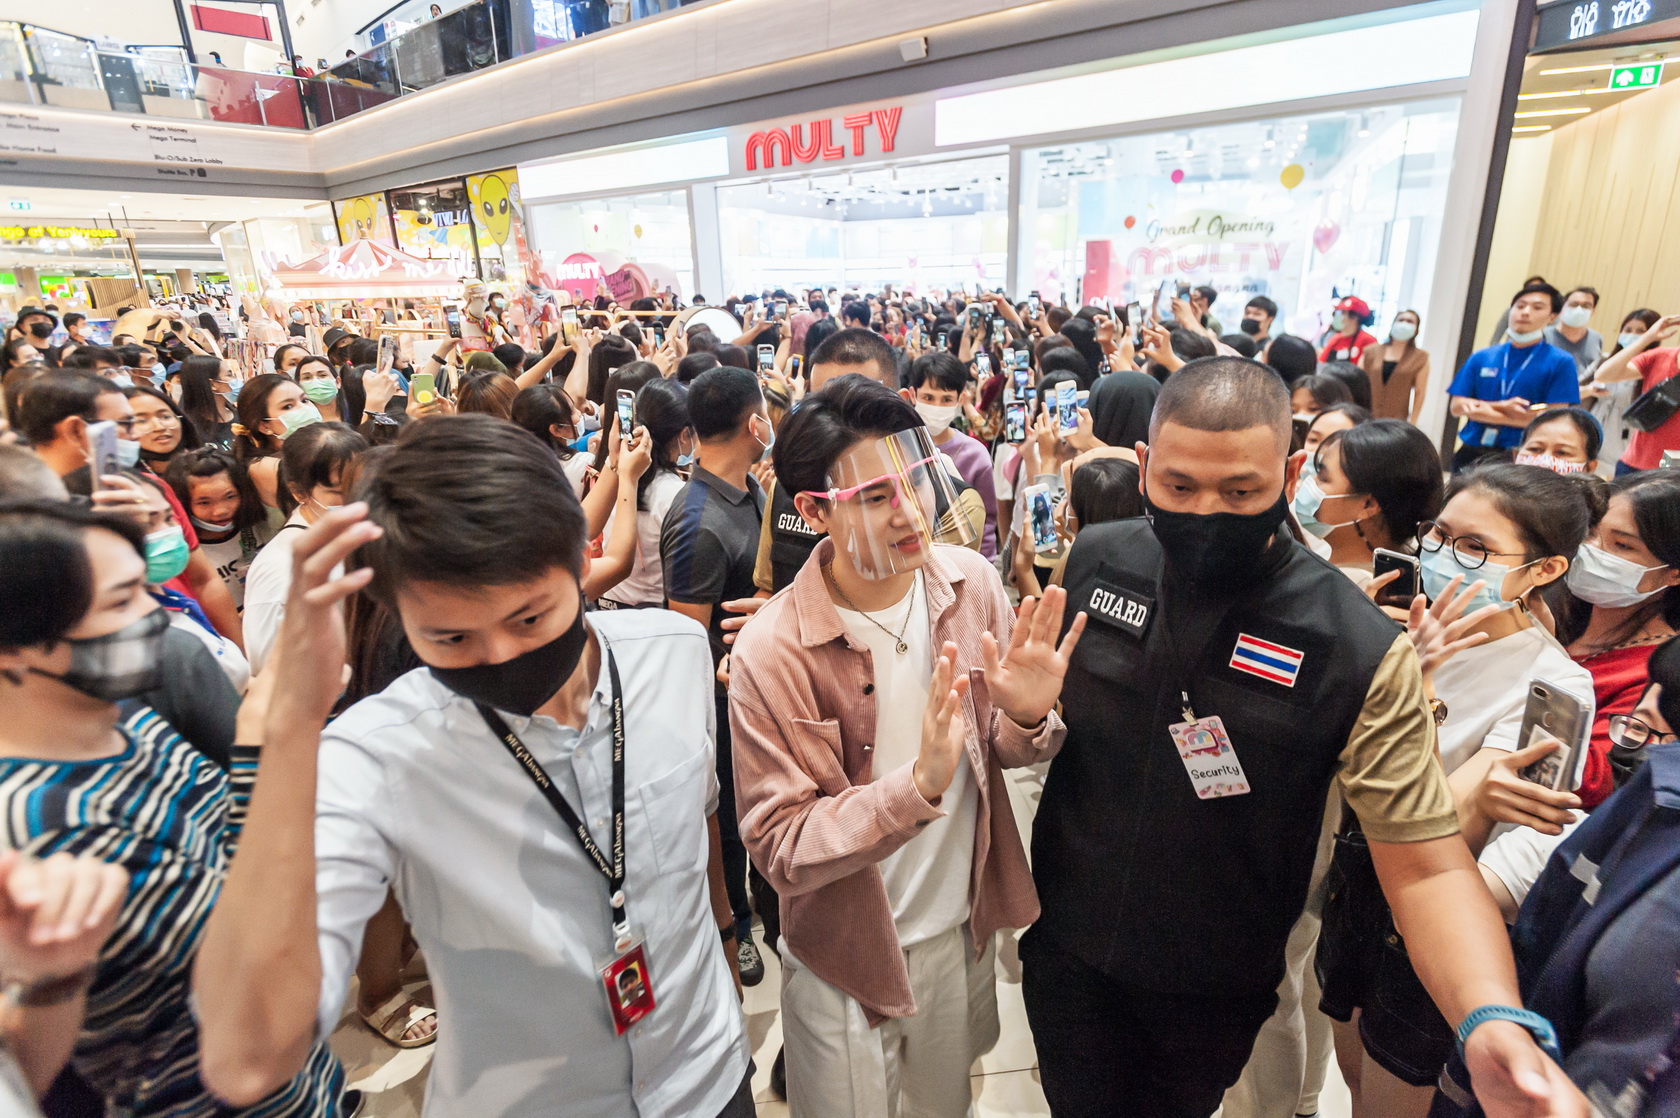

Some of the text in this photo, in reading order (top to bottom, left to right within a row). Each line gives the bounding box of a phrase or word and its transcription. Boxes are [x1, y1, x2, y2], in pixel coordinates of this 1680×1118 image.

[745, 106, 903, 171] MULTY
[1146, 215, 1275, 243] Grand Opening
[318, 246, 392, 280] kiss
[402, 260, 443, 279] me
[556, 261, 600, 280] MULTY
[1126, 241, 1290, 276] MULTY
[1089, 587, 1148, 628] GUARD
[1190, 765, 1240, 780] Security
